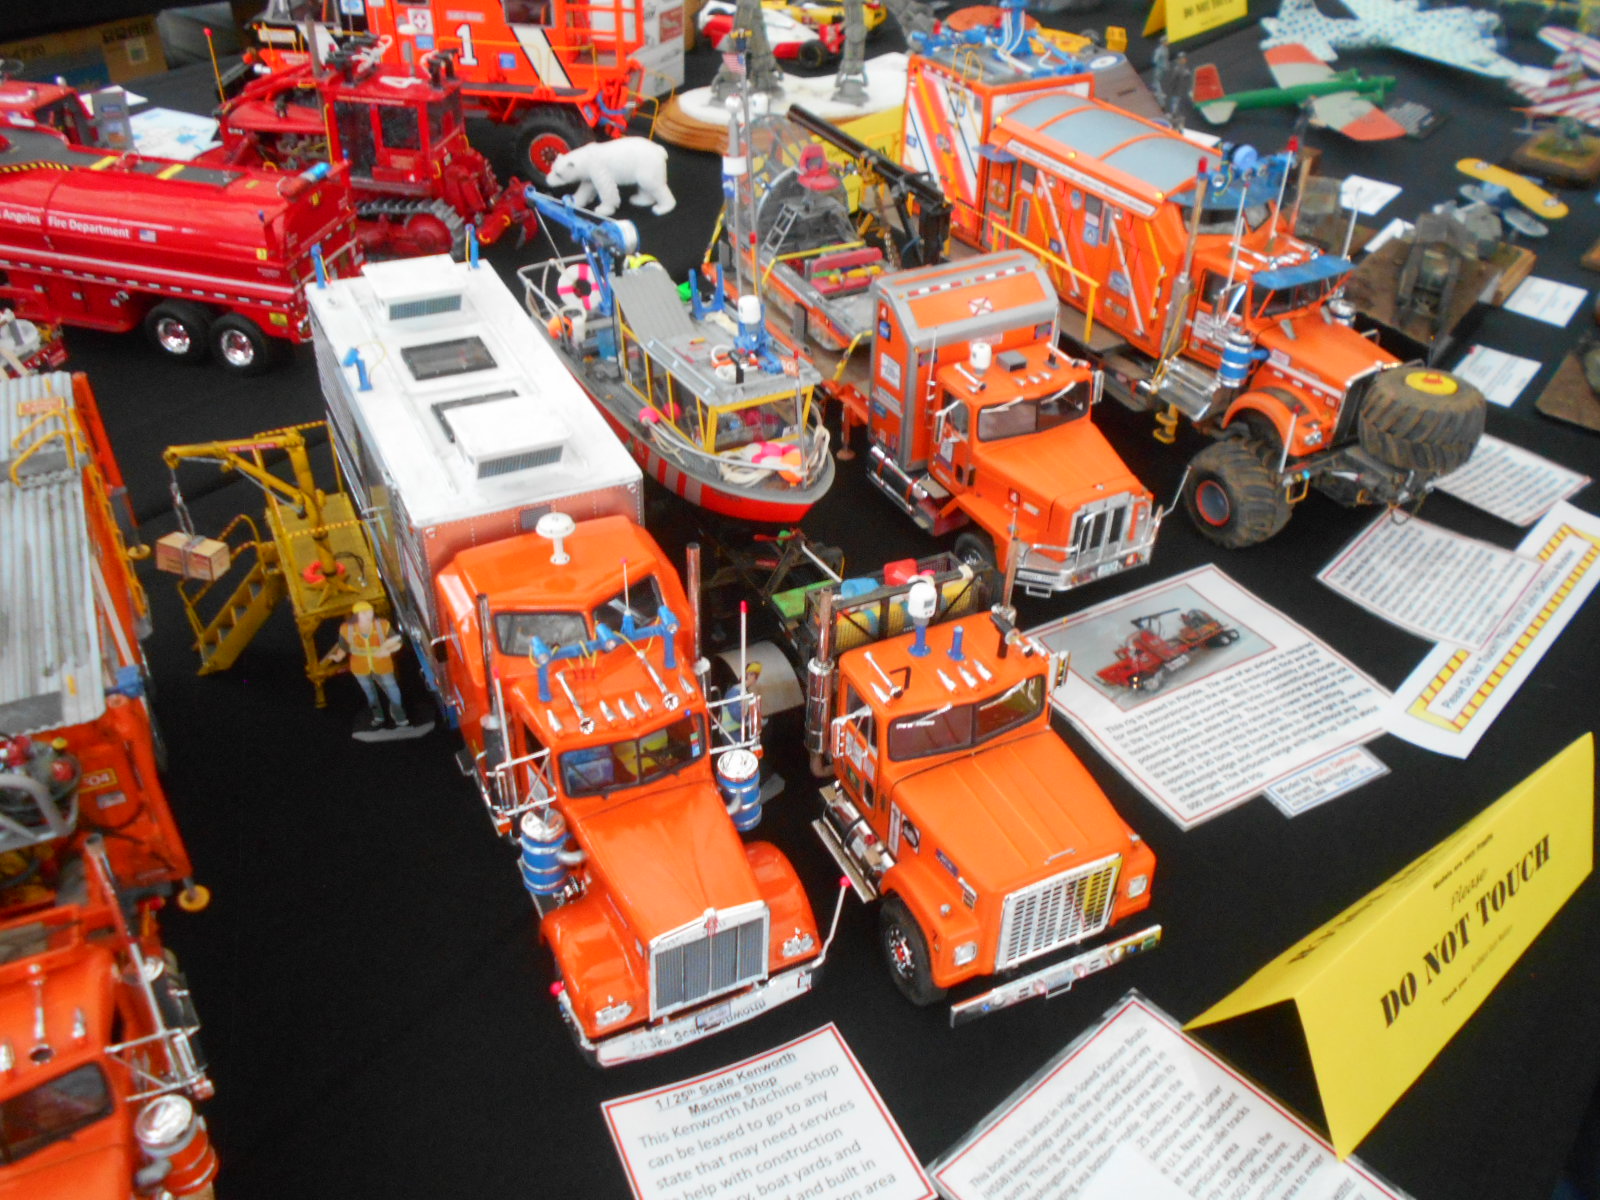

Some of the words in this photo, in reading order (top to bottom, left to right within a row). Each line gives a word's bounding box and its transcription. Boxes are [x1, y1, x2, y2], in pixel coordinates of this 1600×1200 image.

[456, 24, 479, 66] 1
[3, 209, 42, 225] Angeles
[48, 215, 68, 229] Fire
[69, 218, 130, 239] Department
[1450, 867, 1488, 913] Please
[1379, 971, 1418, 1029] DO
[1422, 912, 1471, 986] NOT
[1475, 833, 1551, 928] TOUCH
[686, 1087, 743, 1117] Machine
[742, 1073, 779, 1096] Shop
[698, 1073, 735, 1096] Scale
[734, 1050, 798, 1082] Kenworth
[638, 1127, 671, 1151] This
[670, 1101, 742, 1140] Kenworth
[741, 1078, 805, 1112] Machine
[801, 1062, 843, 1087] Shop
[646, 1150, 675, 1171] can
[674, 1141, 697, 1160] be
[696, 1122, 746, 1151] leased
[745, 1117, 764, 1133] to
[763, 1109, 786, 1127] go
[783, 1100, 803, 1116] to
[801, 1089, 832, 1110] any
[655, 1165, 694, 1192] state
[692, 1151, 726, 1176] that
[726, 1140, 761, 1165] may
[758, 1122, 799, 1148] need
[795, 1097, 858, 1130] services
[681, 1179, 719, 1200] help
[717, 1164, 755, 1191] with
[751, 1127, 848, 1174] construction
[754, 1172, 793, 1198] boat
[790, 1153, 836, 1183] yards
[832, 1139, 864, 1161] and
[793, 1179, 826, 1200] and
[822, 1163, 862, 1190] built
[857, 1154, 878, 1173] in
[860, 1171, 900, 1197] area
